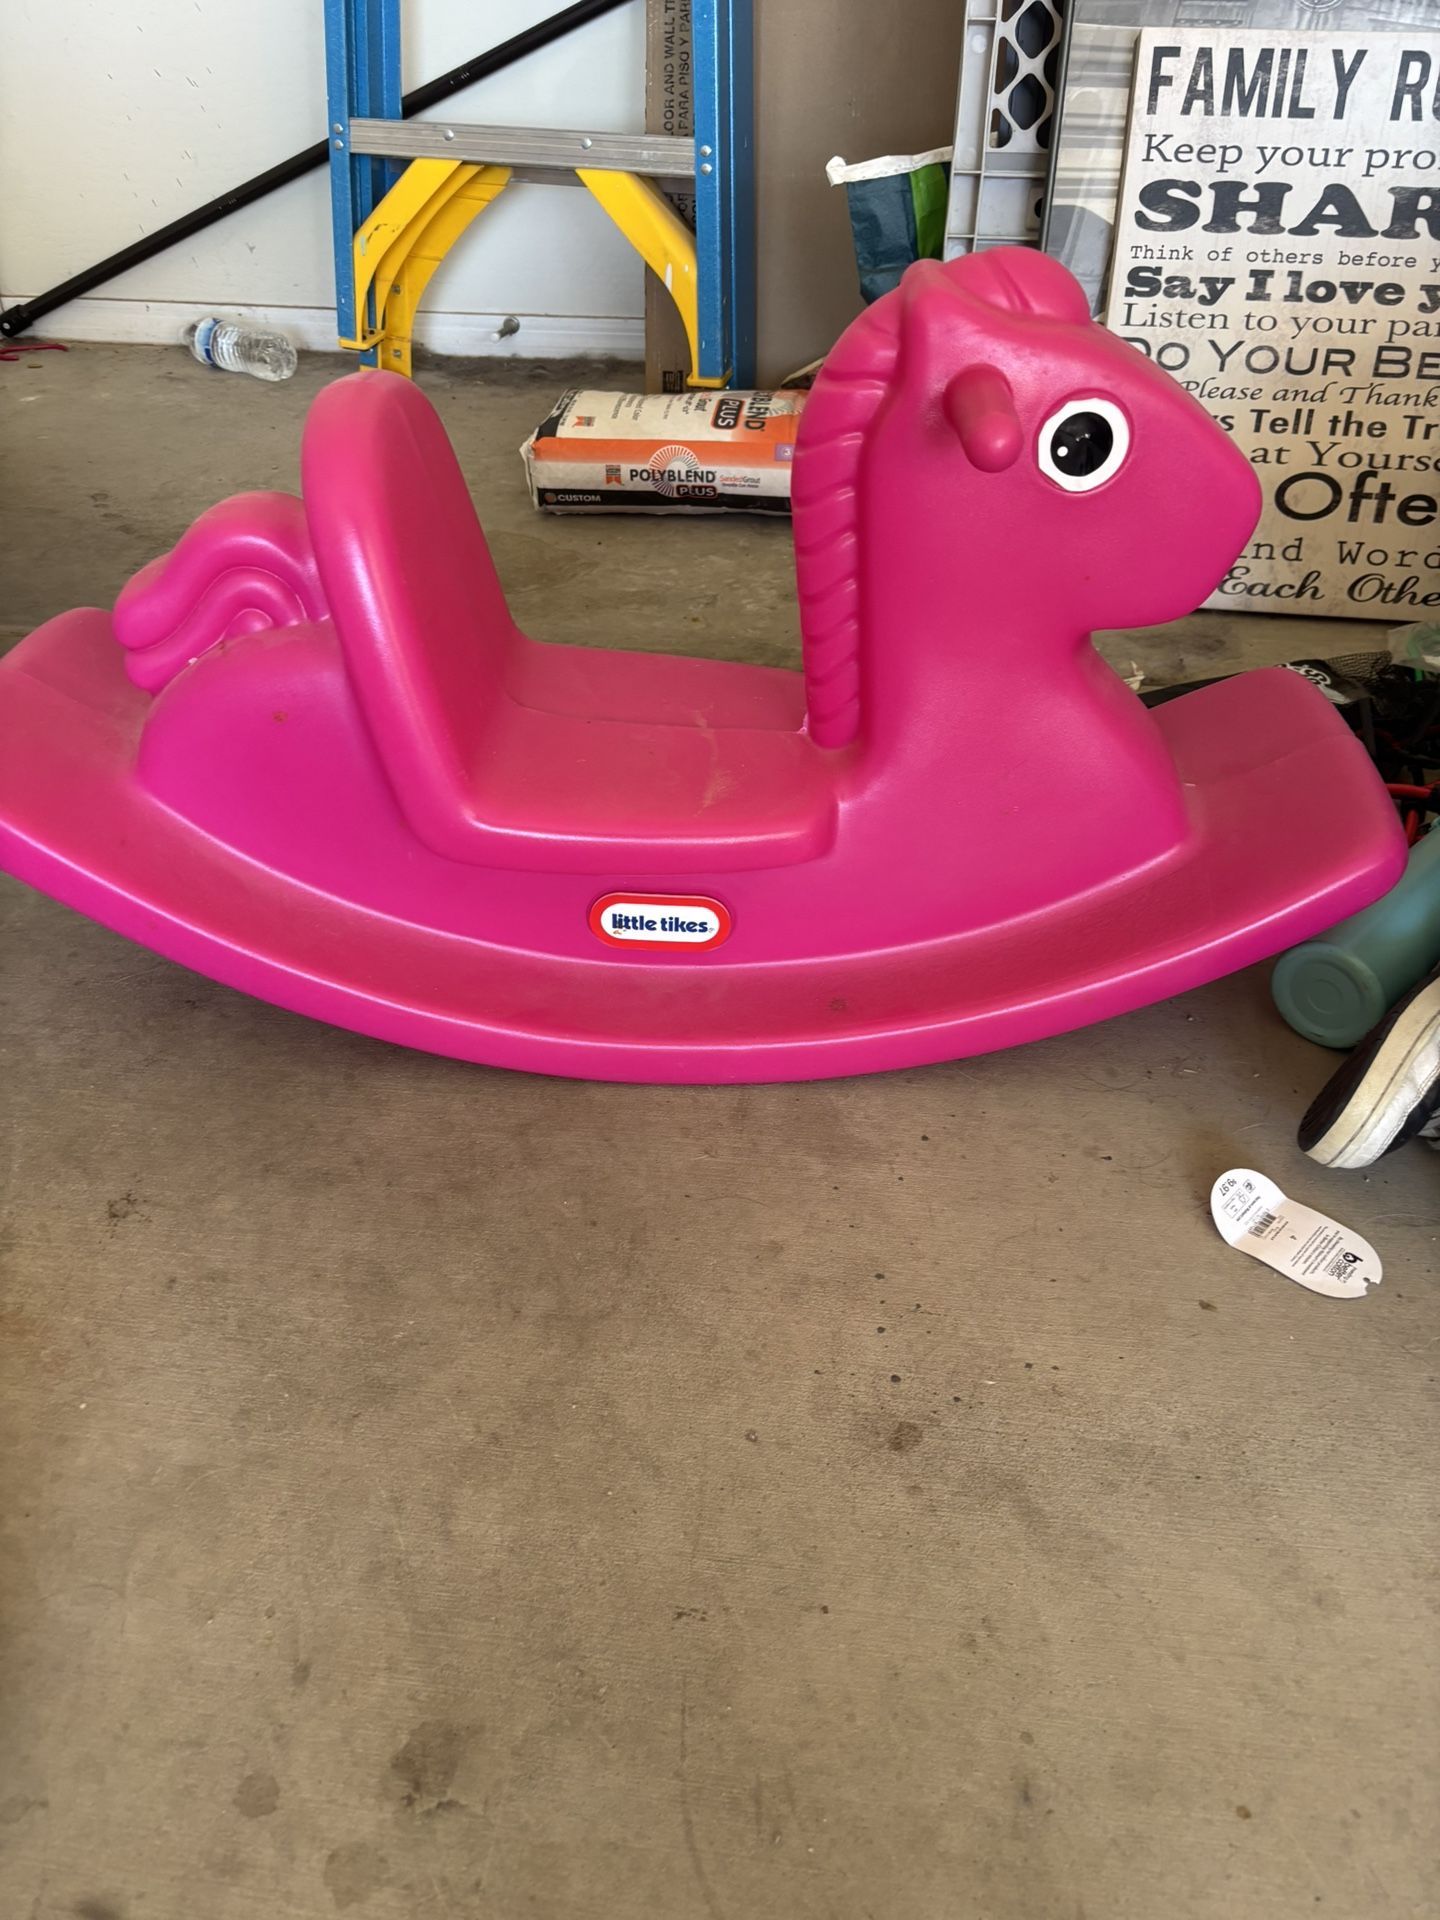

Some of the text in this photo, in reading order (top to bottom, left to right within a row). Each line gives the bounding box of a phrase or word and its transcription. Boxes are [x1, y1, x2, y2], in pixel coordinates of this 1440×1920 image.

[663, 18, 675, 59] WALL
[663, 63, 675, 95] AND
[678, 0, 691, 130] PARA PISO Y PAR
[1146, 46, 1368, 120] FAMILY
[663, 100, 675, 136] OOR
[1142, 133, 1440, 178] Keep your pro
[1134, 178, 1440, 241] SHAR
[1130, 244, 1193, 261] Think
[1207, 246, 1233, 262] of
[1246, 248, 1324, 265] others
[1338, 250, 1418, 268] before
[1124, 265, 1235, 307] Say
[1245, 268, 1276, 302] I
[1283, 270, 1406, 307] love
[1119, 302, 1229, 330] Listen
[1243, 311, 1278, 332] to
[1289, 316, 1377, 340] your
[1208, 339, 1356, 377] YOUR
[1272, 381, 1338, 404] and
[1339, 382, 1440, 408] Thank
[717, 400, 740, 427] PLUS
[1250, 408, 1316, 435] Tell
[1328, 410, 1387, 438] the
[1250, 446, 1291, 466] at
[629, 468, 716, 483] POLYBLEND
[679, 487, 715, 497] PLUS
[557, 494, 602, 502] CUSTOM
[1274, 470, 1439, 527] Ofte
[1237, 537, 1304, 563] nd
[1217, 565, 1440, 607] Each Othe
[611, 913, 708, 933] little tikes
